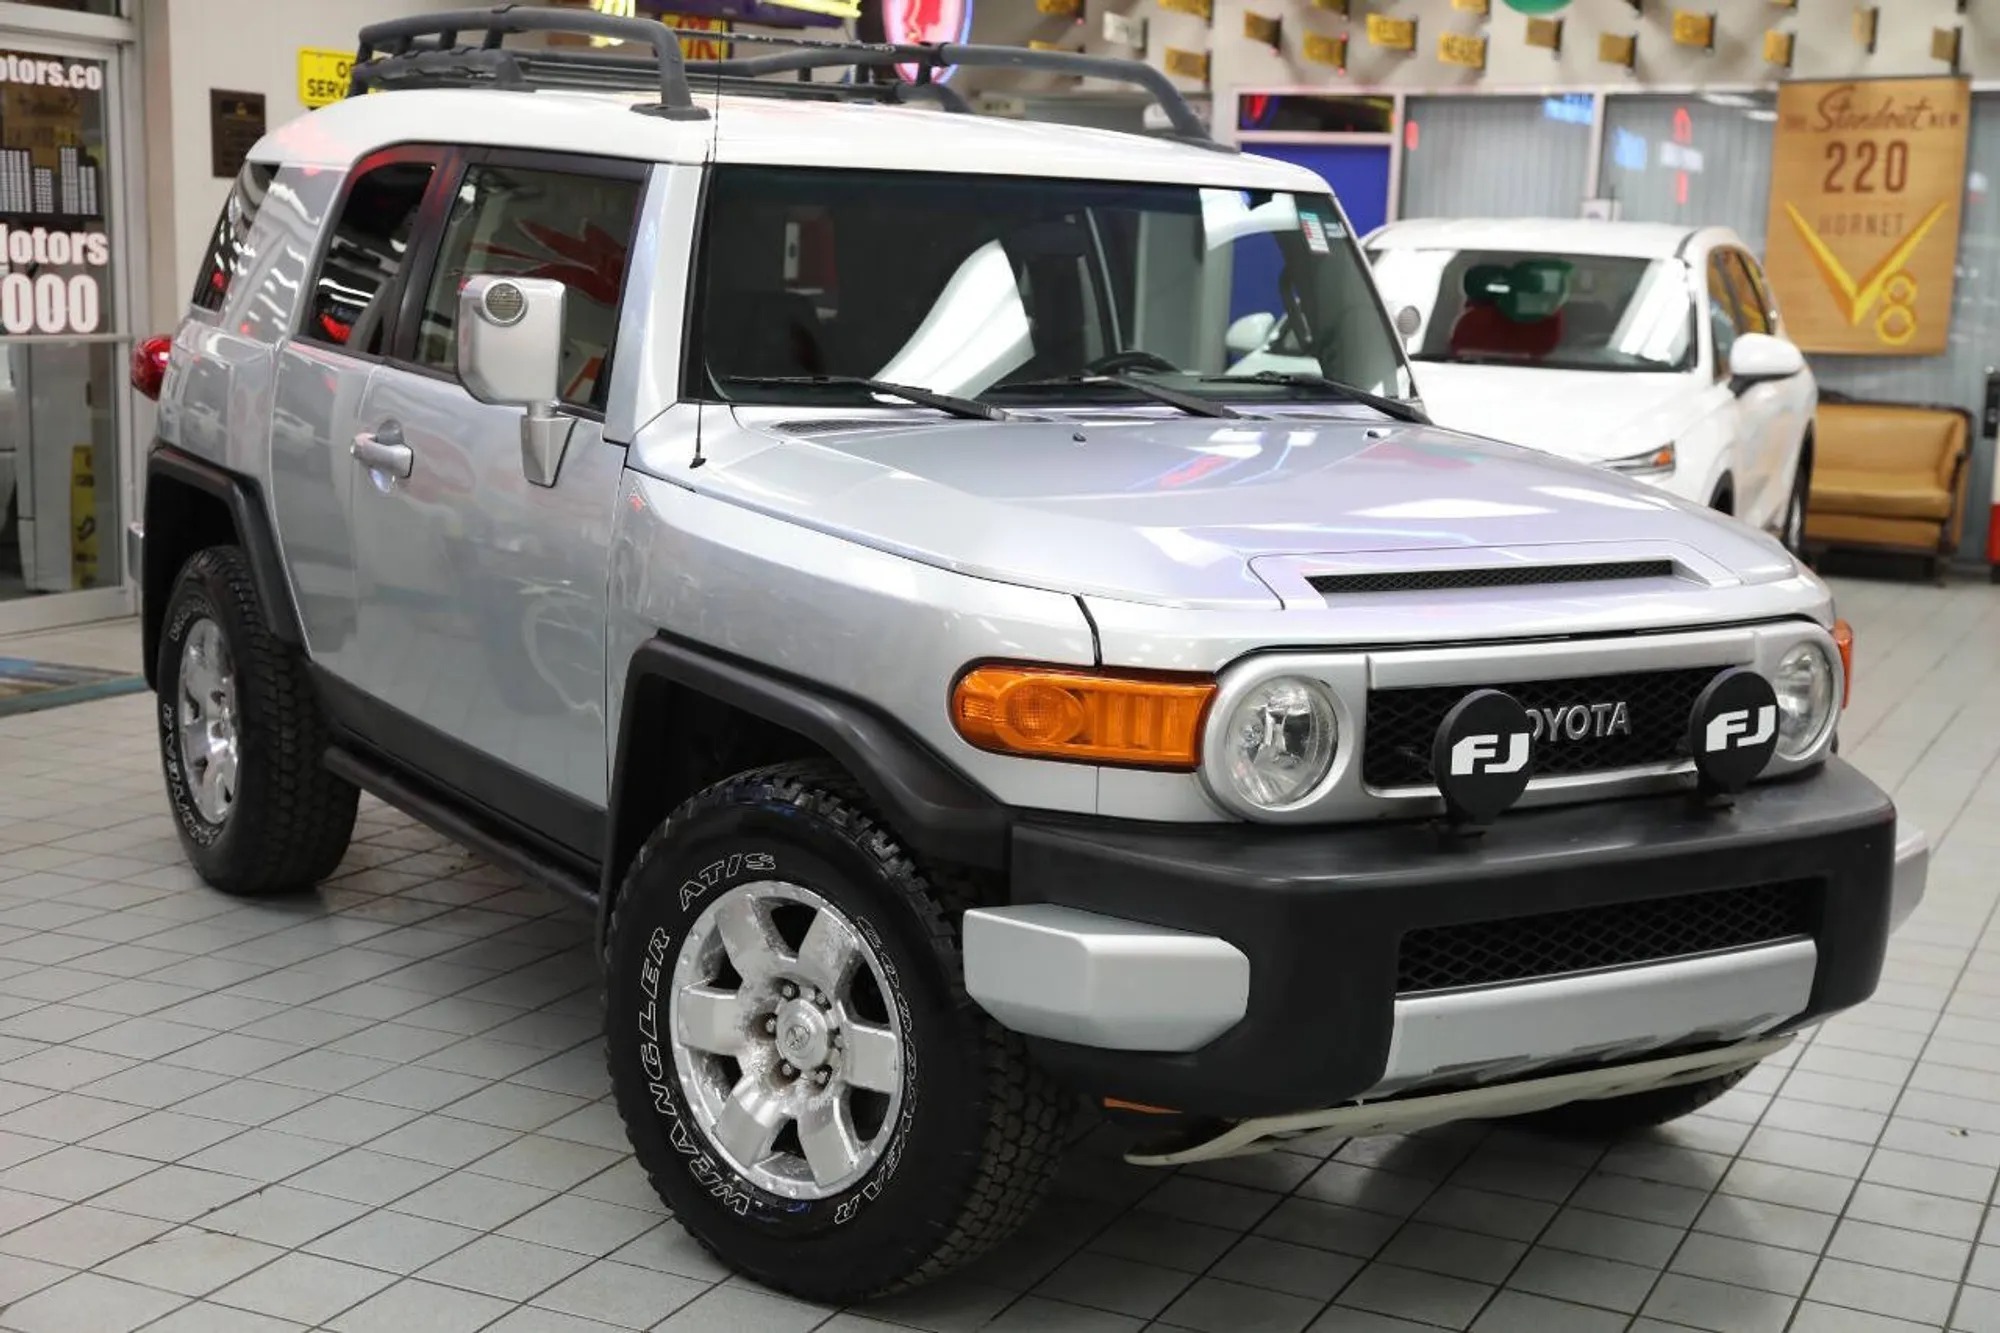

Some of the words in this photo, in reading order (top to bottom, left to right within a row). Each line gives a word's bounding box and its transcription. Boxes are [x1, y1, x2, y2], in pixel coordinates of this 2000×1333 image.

[1822, 140, 1909, 194] 220
[0, 223, 109, 267] otors
[1817, 211, 1906, 238] HORNET
[1525, 701, 1632, 743] OYOTA
[1705, 704, 1777, 753] FJ
[1451, 732, 1530, 776] FJ
[638, 926, 751, 1216] WRANGLER
